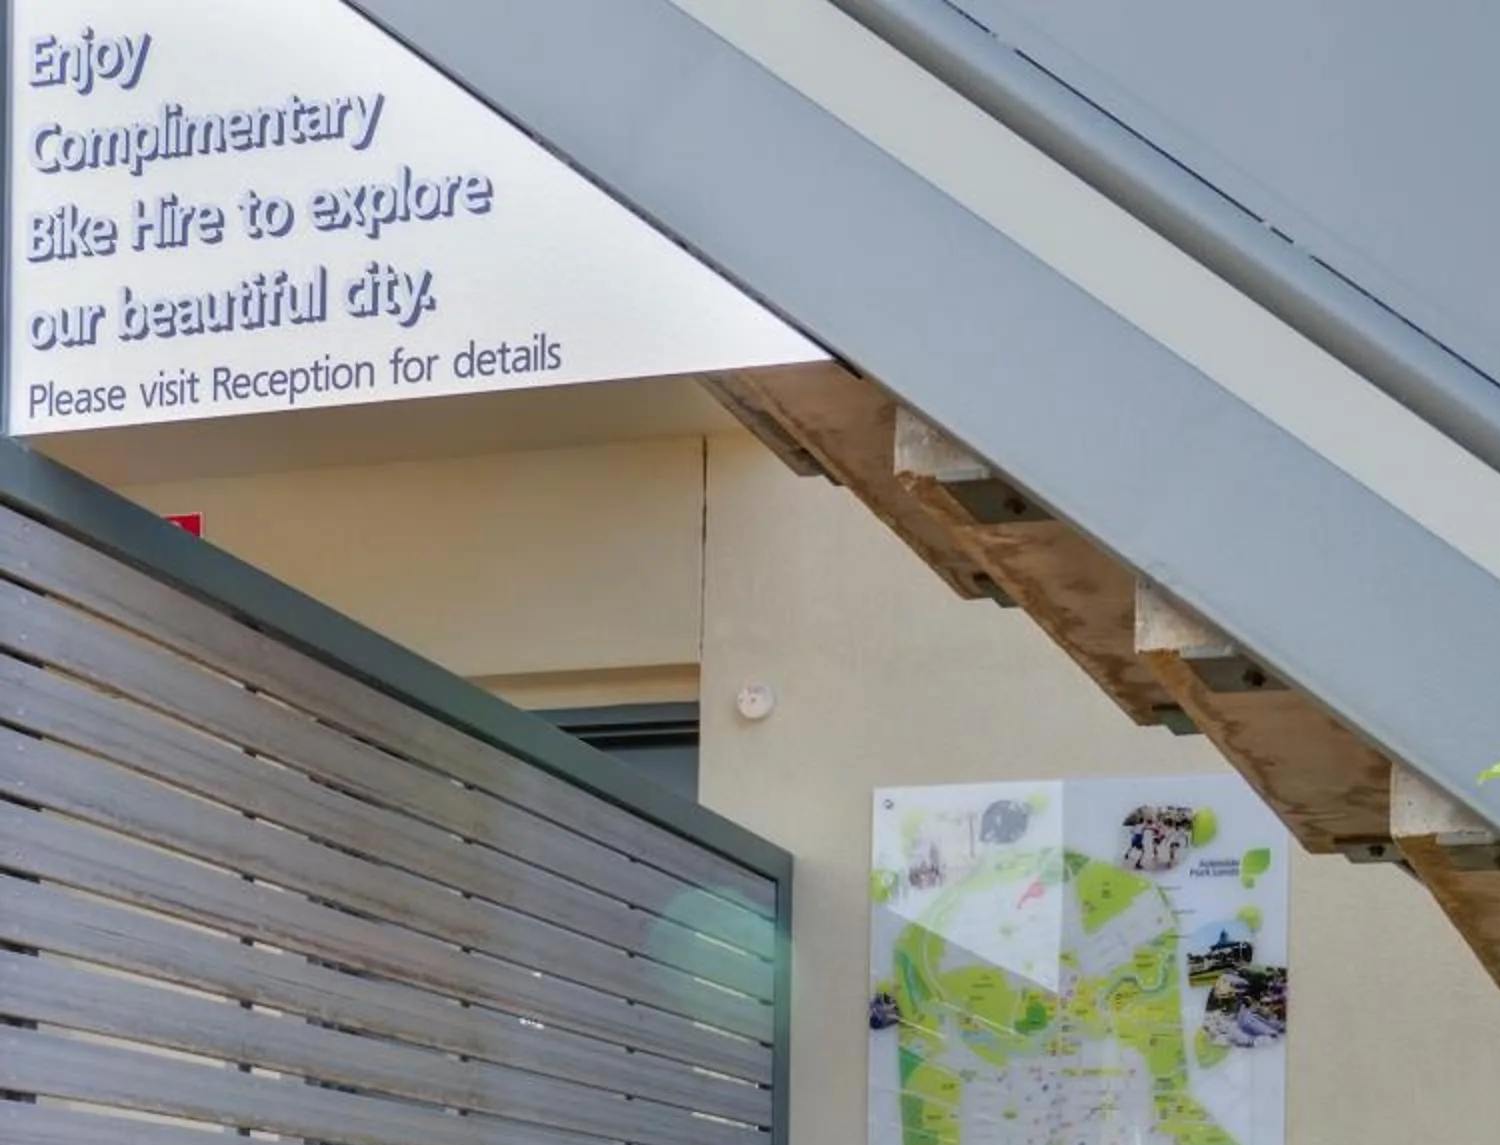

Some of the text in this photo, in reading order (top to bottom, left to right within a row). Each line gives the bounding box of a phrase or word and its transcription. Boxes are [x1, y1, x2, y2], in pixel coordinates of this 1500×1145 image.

[29, 26, 152, 95] Enjoy
[29, 92, 385, 176] Complimentary
[26, 165, 494, 263] Bike Hire to explore
[28, 260, 437, 351] our beautiful city.
[29, 333, 562, 418] Please visit Reception for details
